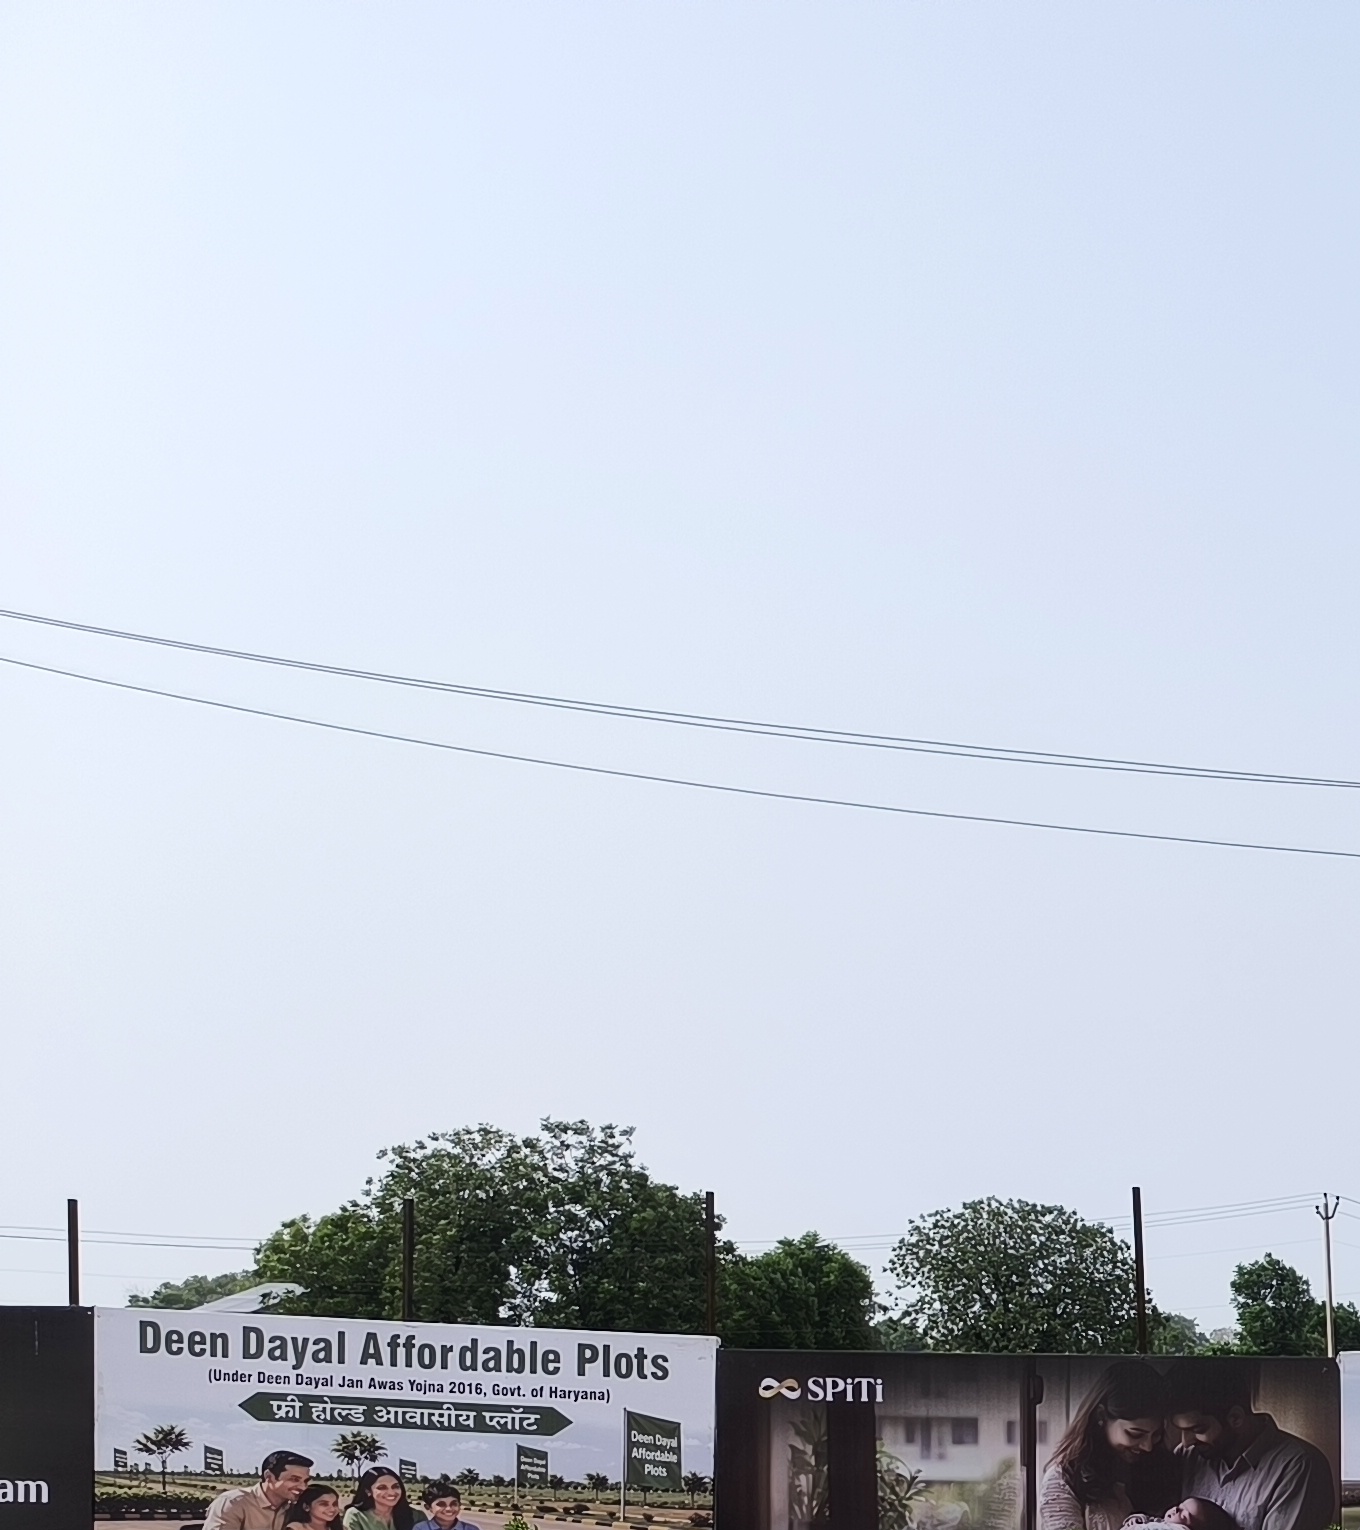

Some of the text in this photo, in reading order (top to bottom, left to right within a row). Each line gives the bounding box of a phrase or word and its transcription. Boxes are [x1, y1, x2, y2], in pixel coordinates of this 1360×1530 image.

[139, 1320, 670, 1381] Deen Dayal Affordable Plots
[208, 1368, 611, 1404] (Under Deen Dayal Jan Awas Yojna 2016, Govt. of Haryana)
[270, 1395, 541, 1432] फ्री होल्ड आवासीय प्लॉट
[631, 1430, 678, 1450] Deen Dayal
[631, 1447, 678, 1463] Affordable
[644, 1463, 668, 1477] Plots
